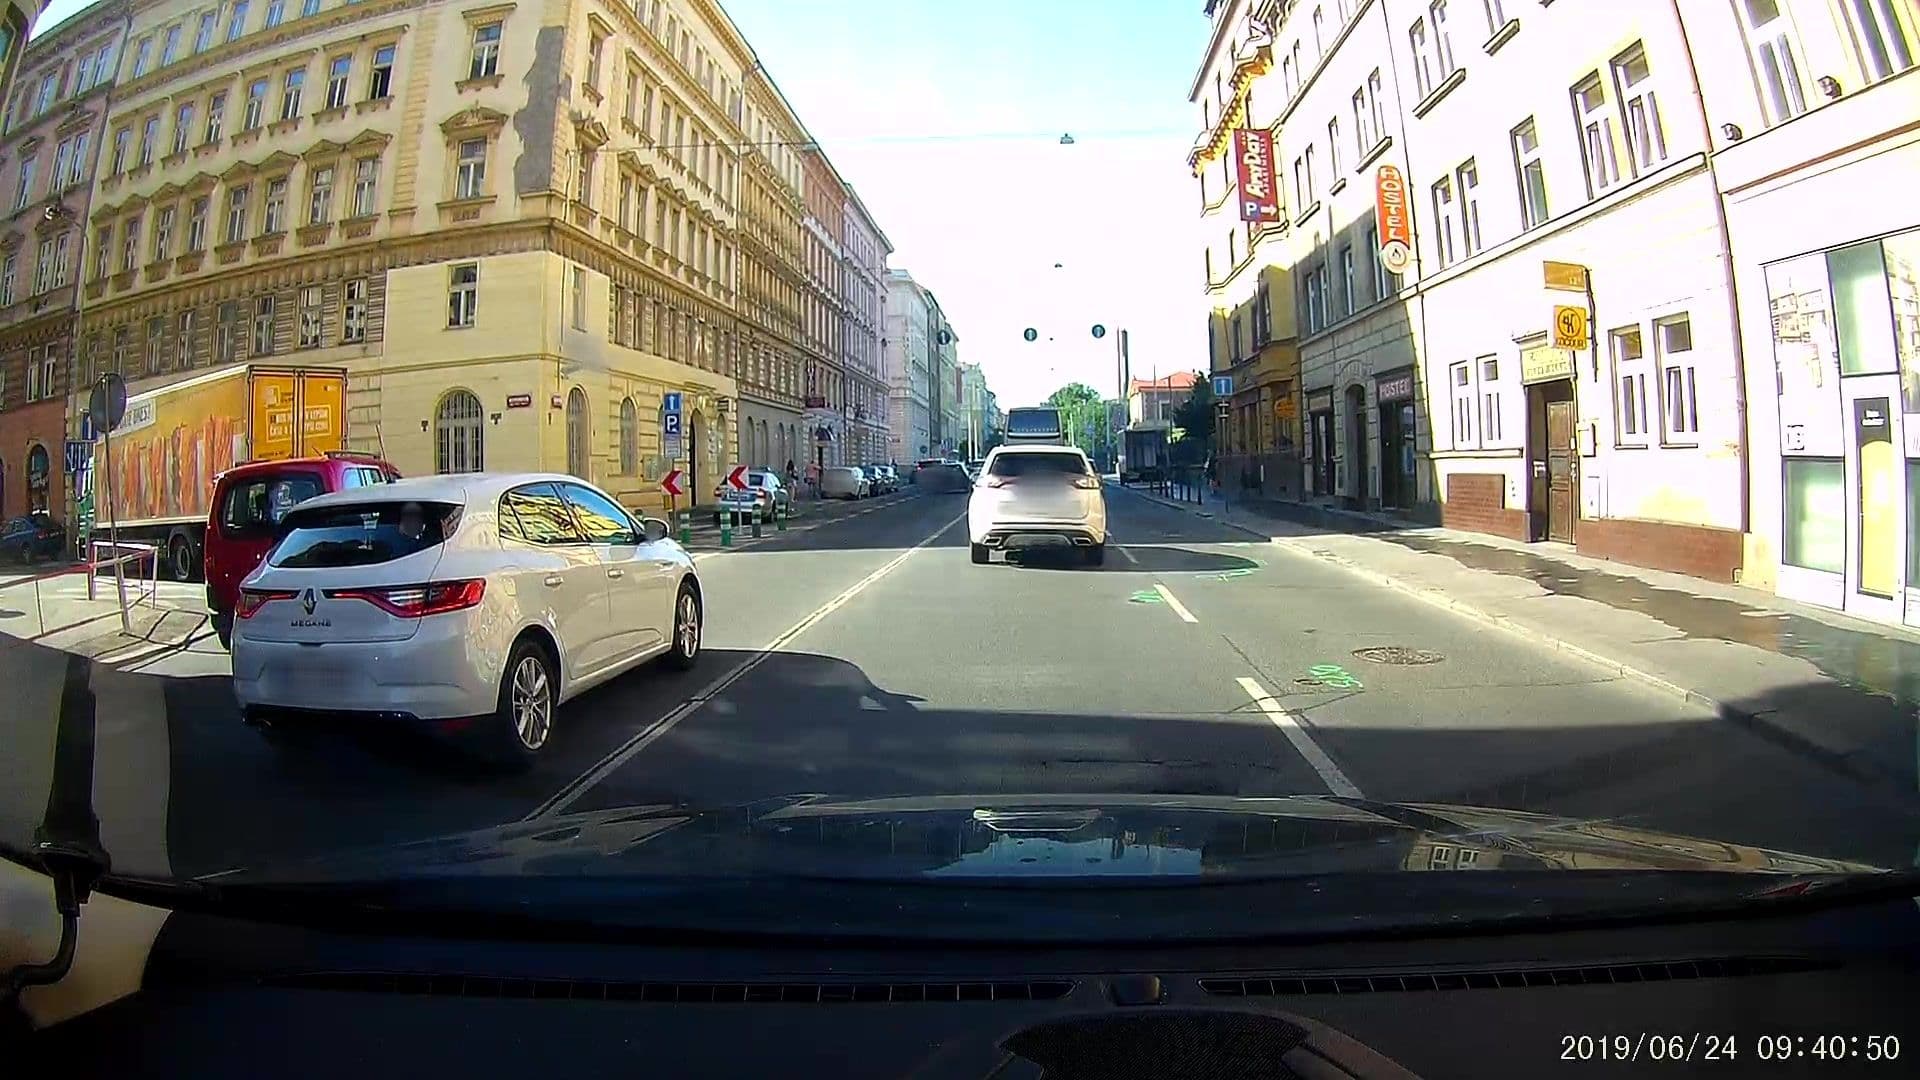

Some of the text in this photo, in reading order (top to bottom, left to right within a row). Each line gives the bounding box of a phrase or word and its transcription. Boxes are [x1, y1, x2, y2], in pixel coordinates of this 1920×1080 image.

[1245, 201, 1258, 217] P
[1380, 167, 1405, 240] HOSTEL
[667, 415, 678, 431] P
